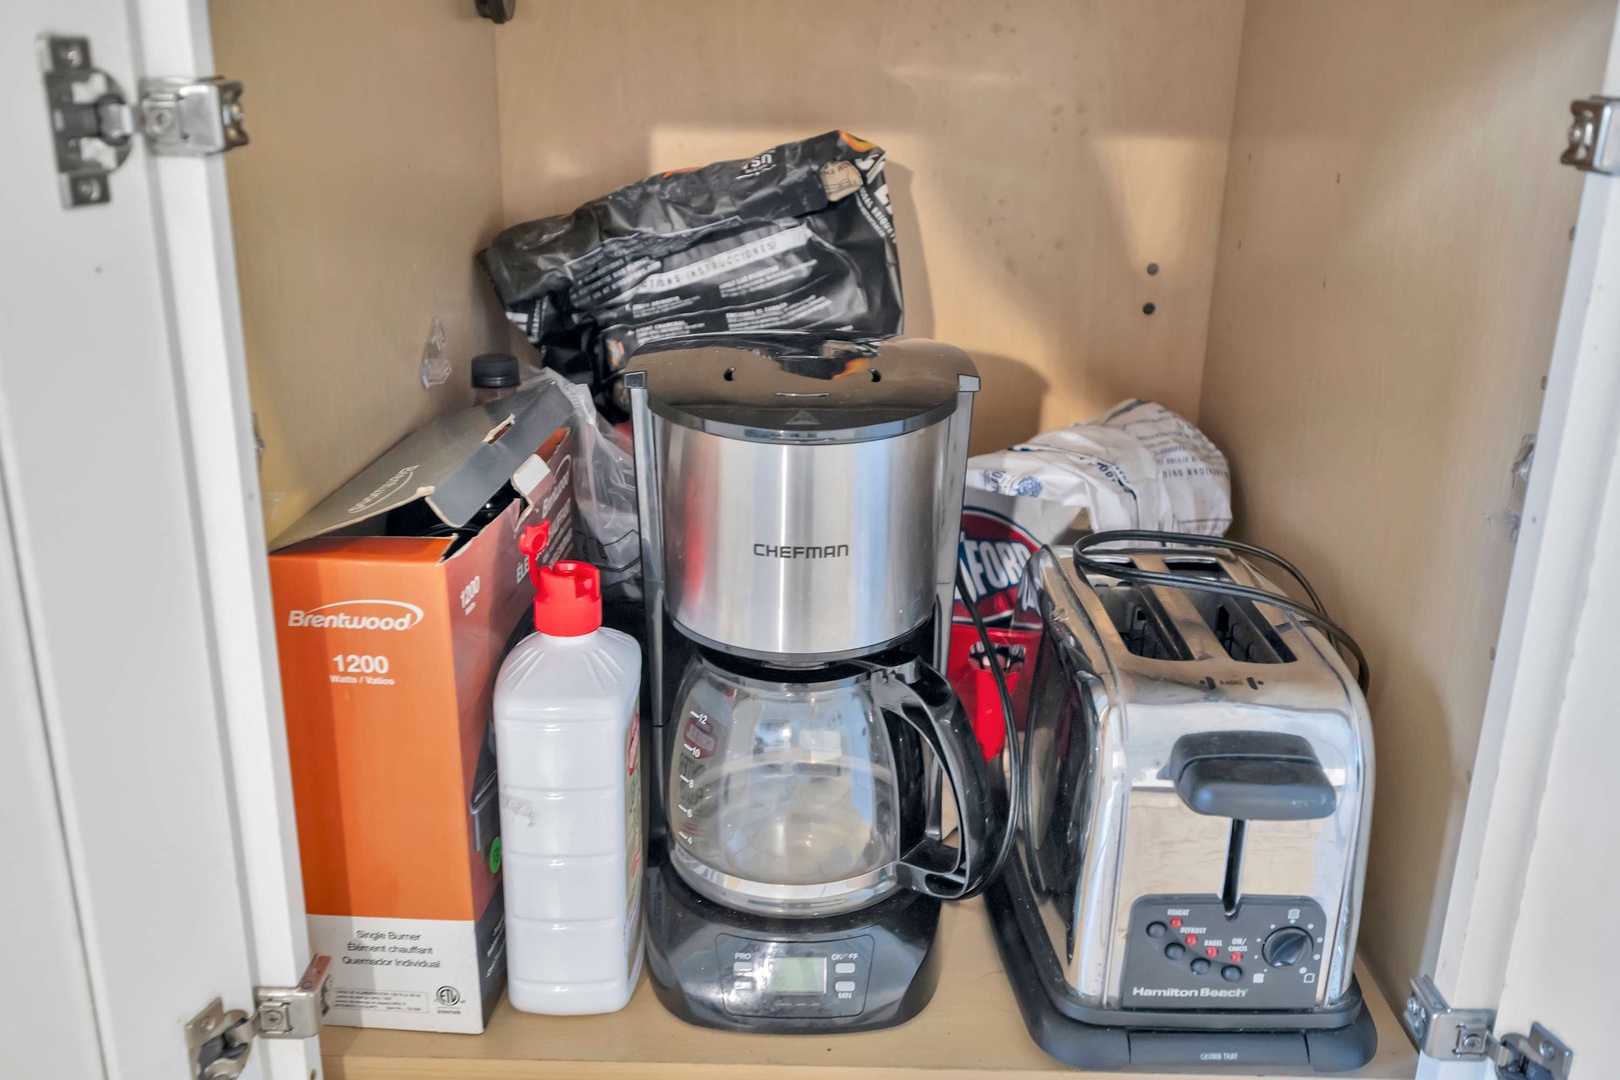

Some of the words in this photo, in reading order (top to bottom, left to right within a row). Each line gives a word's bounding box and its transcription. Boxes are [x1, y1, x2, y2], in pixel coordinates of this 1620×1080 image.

[753, 543, 849, 559] CHEFMAN
[288, 609, 412, 631] Brentwood
[333, 654, 389, 674] 1200
[330, 675, 357, 684] Watts
[365, 676, 395, 685] Vatios
[1167, 908, 1191, 916] REHEAT
[356, 930, 386, 941] Single
[388, 931, 421, 941] Burner
[1180, 926, 1207, 935] DEFROST
[1204, 939, 1223, 947] BAGEL
[388, 944, 433, 954] chauffant
[342, 956, 393, 967] Quemador
[395, 957, 441, 968] Individual
[838, 991, 853, 999] MIN
[1132, 986, 1199, 998] Hamilton
[1200, 987, 1246, 998] Beach
[1223, 1052, 1238, 1060] TRAY
